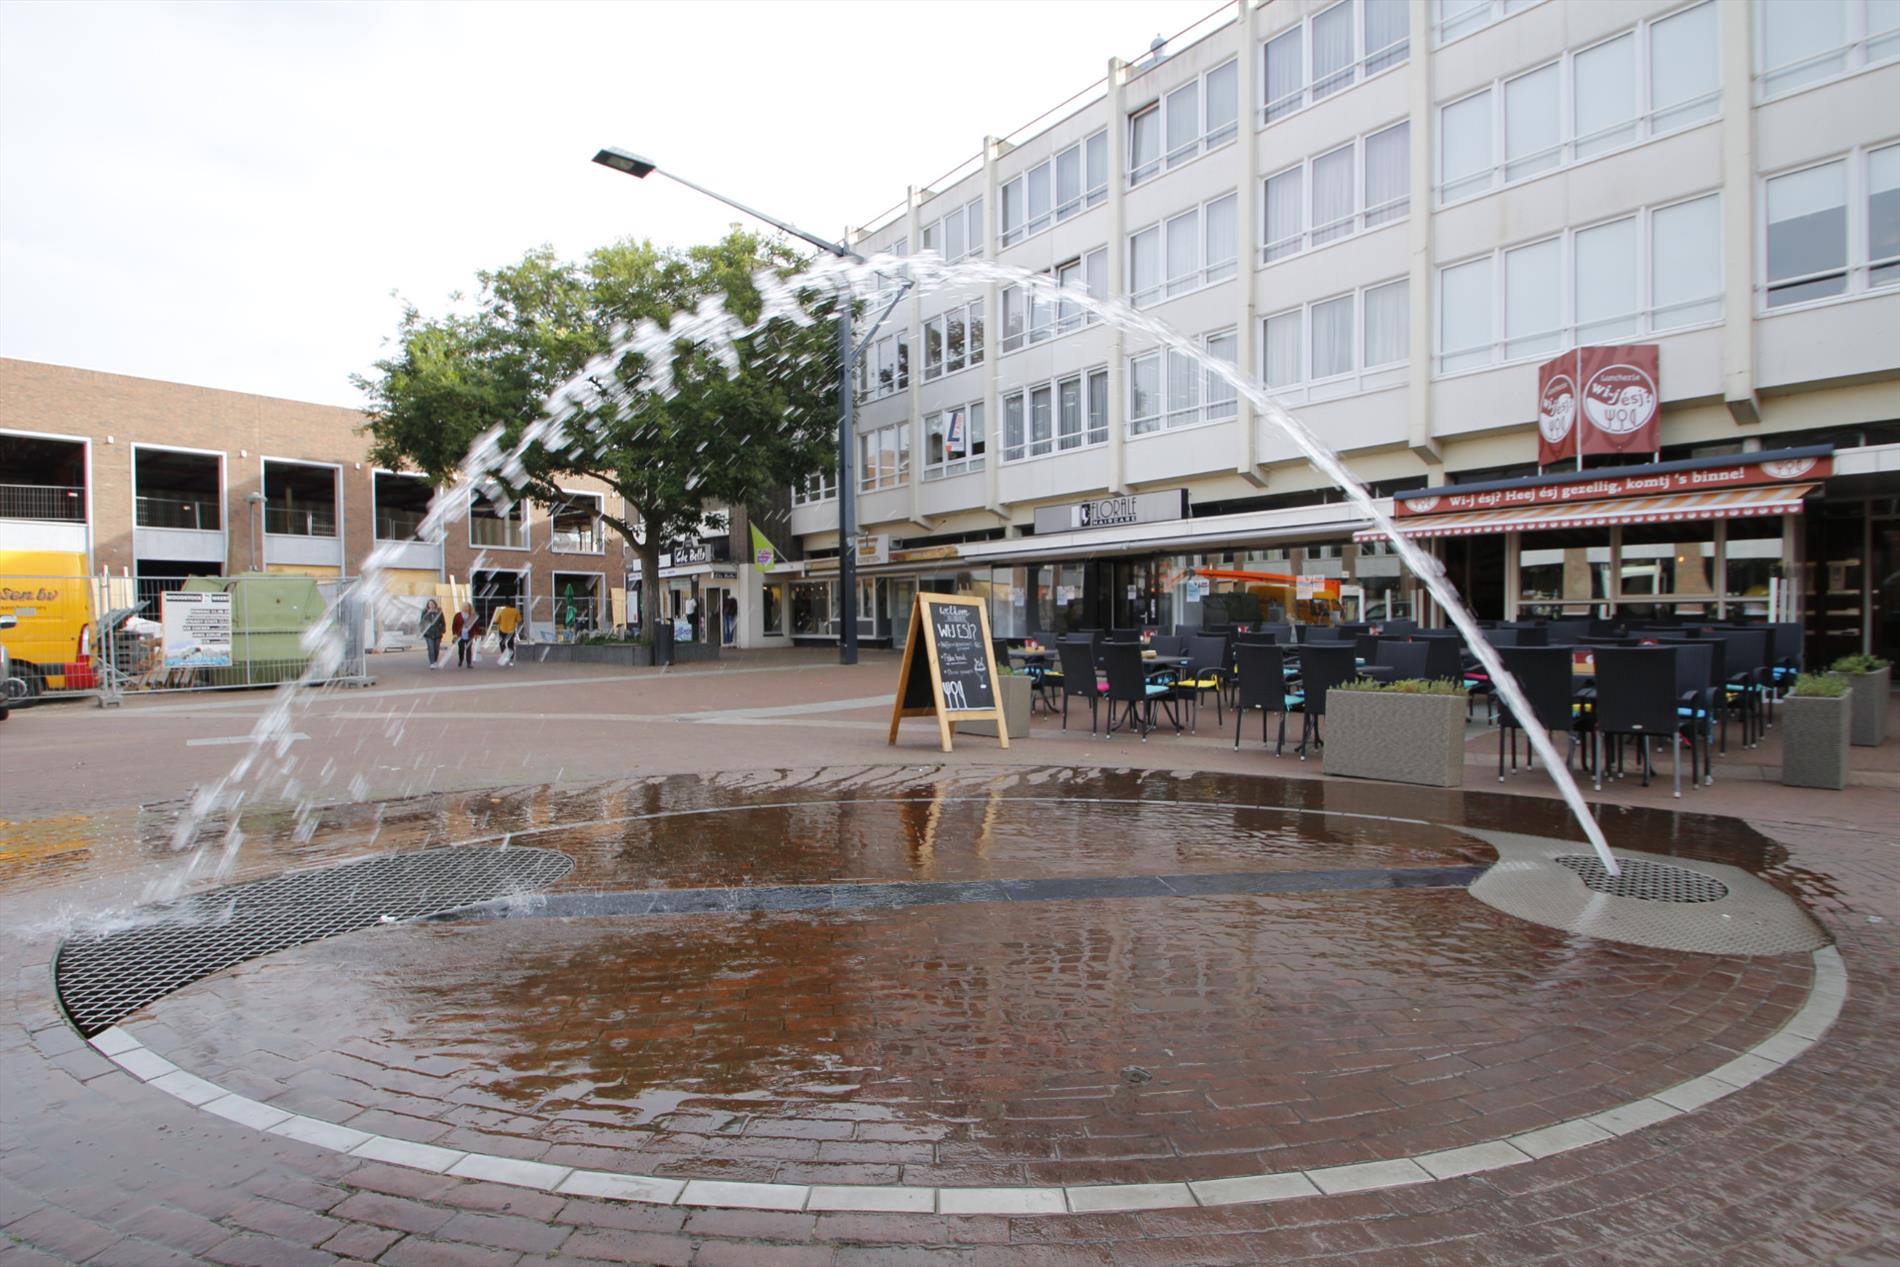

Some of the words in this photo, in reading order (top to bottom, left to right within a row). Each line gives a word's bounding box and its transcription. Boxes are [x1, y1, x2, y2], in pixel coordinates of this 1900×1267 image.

[1450, 497, 1475, 507] Wi-j
[1478, 494, 1502, 504] ésj?
[1506, 489, 1536, 502] Heej
[1539, 485, 1558, 499] ésj
[1562, 479, 1622, 498] gezellig,
[1626, 475, 1670, 491] komtj
[1692, 467, 1745, 483] binne!
[1091, 496, 1136, 519] FLORALE
